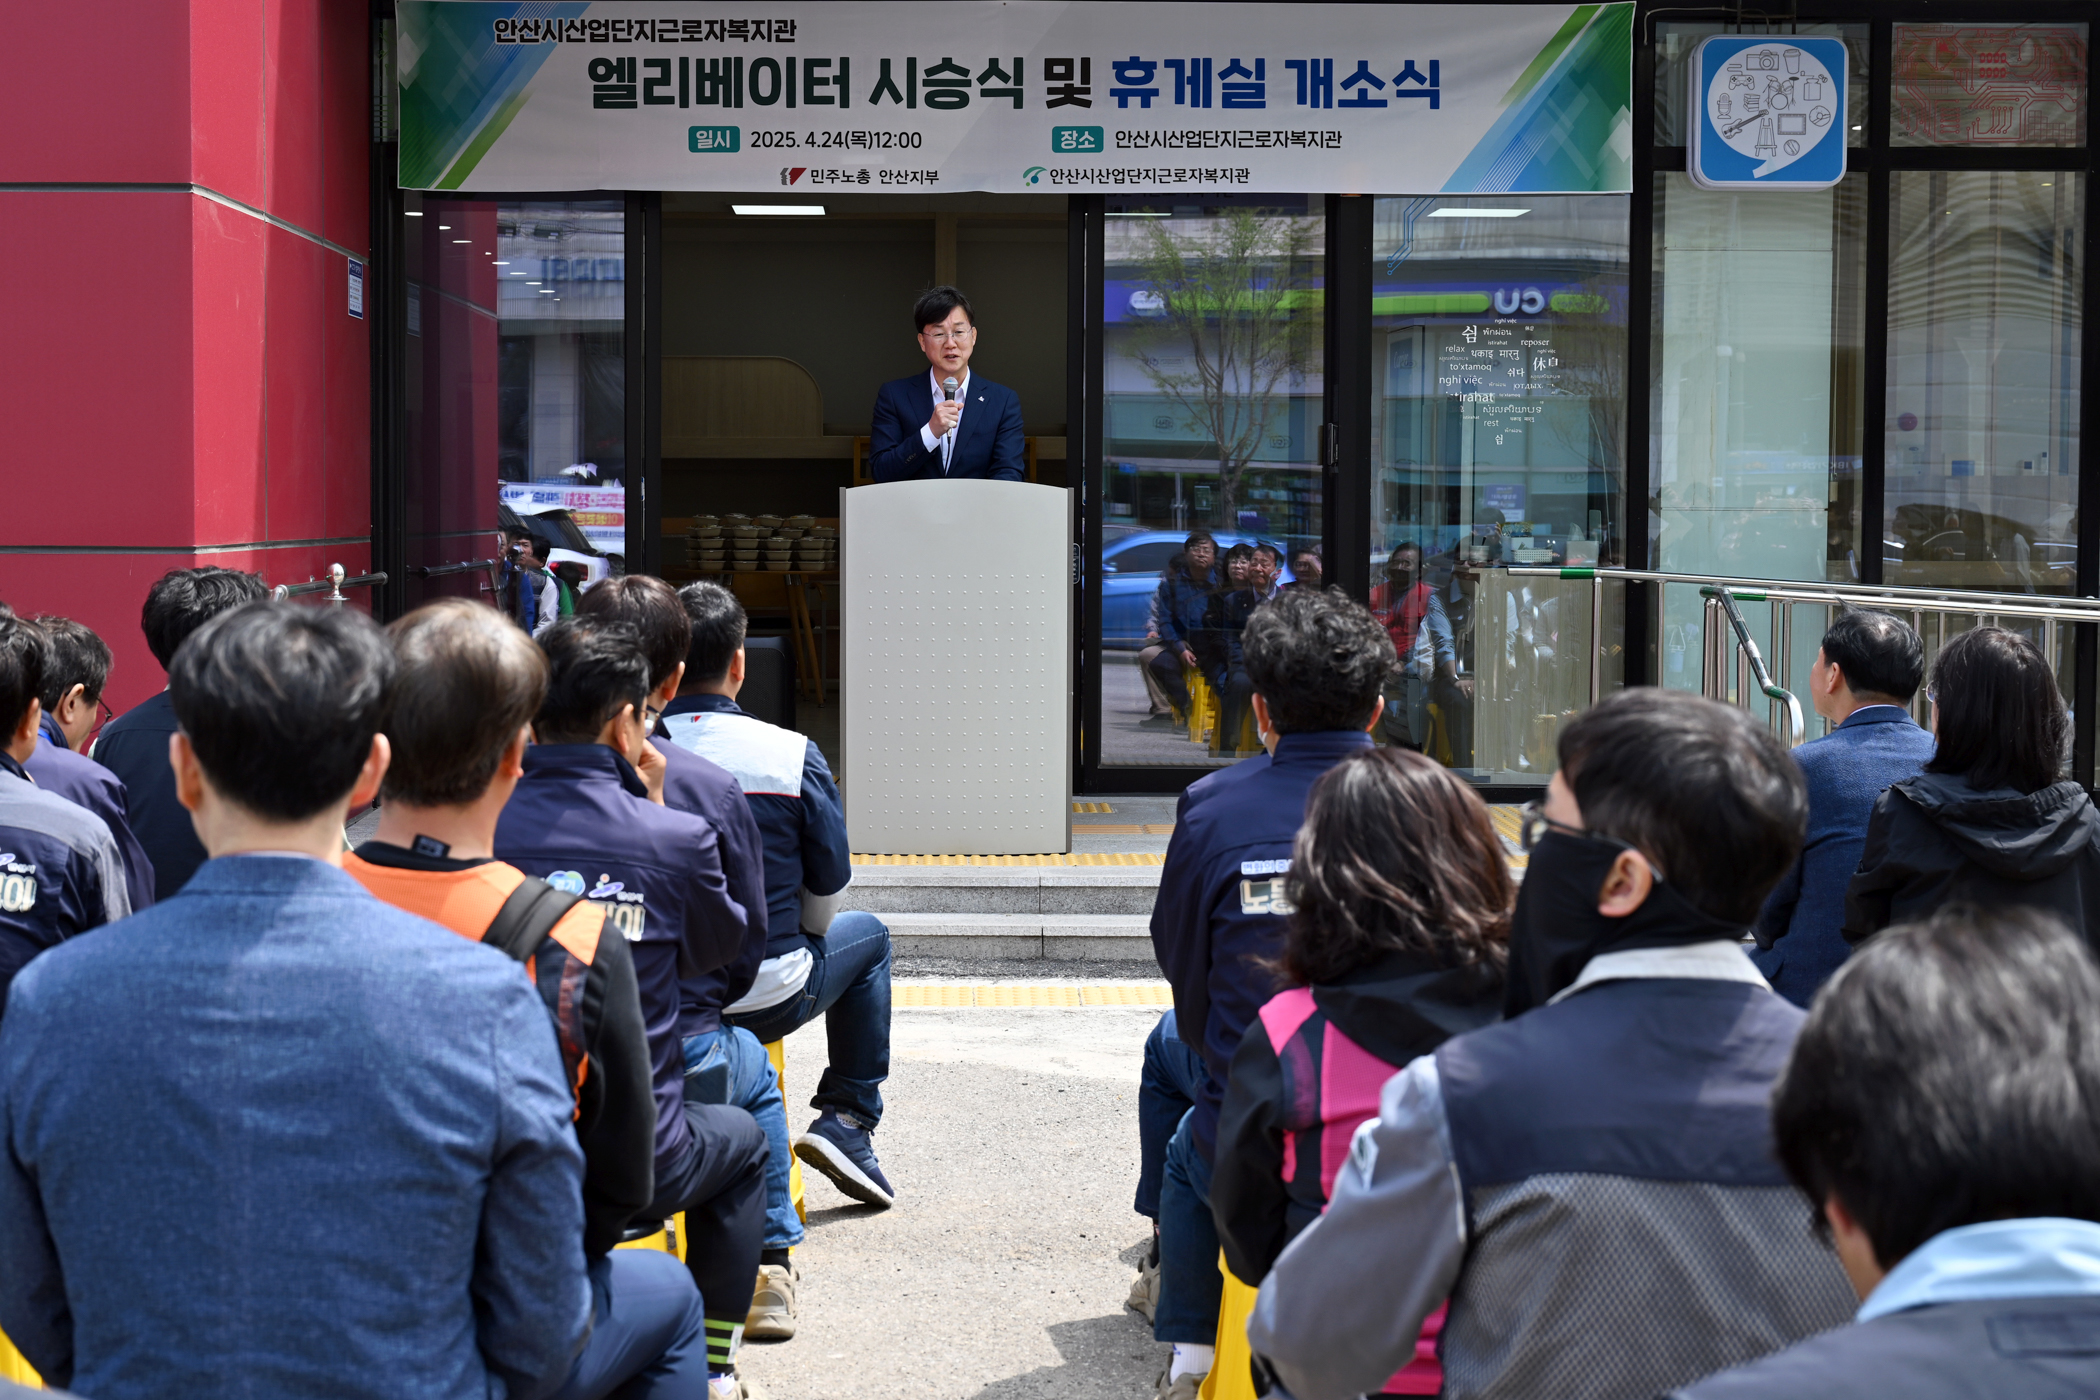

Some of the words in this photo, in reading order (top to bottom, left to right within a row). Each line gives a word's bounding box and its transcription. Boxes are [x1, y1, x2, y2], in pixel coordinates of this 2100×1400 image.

[493, 18, 797, 44] 안산시산업단지근로자복지관
[587, 56, 850, 109] 엘리베이터
[868, 57, 1024, 109] 시승식
[1044, 57, 1093, 109] 및
[1109, 56, 1267, 108] 휴게실
[1284, 58, 1441, 110] 개소식
[695, 130, 731, 149] 일시
[750, 131, 800, 148] 2025.
[804, 131, 923, 150] 4.24(목)12:00
[1060, 130, 1096, 149] 장소
[1115, 130, 1343, 149] 안산시산업단지근로자복지관
[810, 168, 872, 185] 민주노총
[878, 169, 940, 185] 안산지부
[1049, 168, 1251, 185] 안산시산업단지근로자복지관
[1462, 325, 1477, 343] 쉼
[1445, 344, 1466, 353] relax
[1520, 339, 1550, 348] reposer
[1507, 367, 1526, 378] 쉬다
